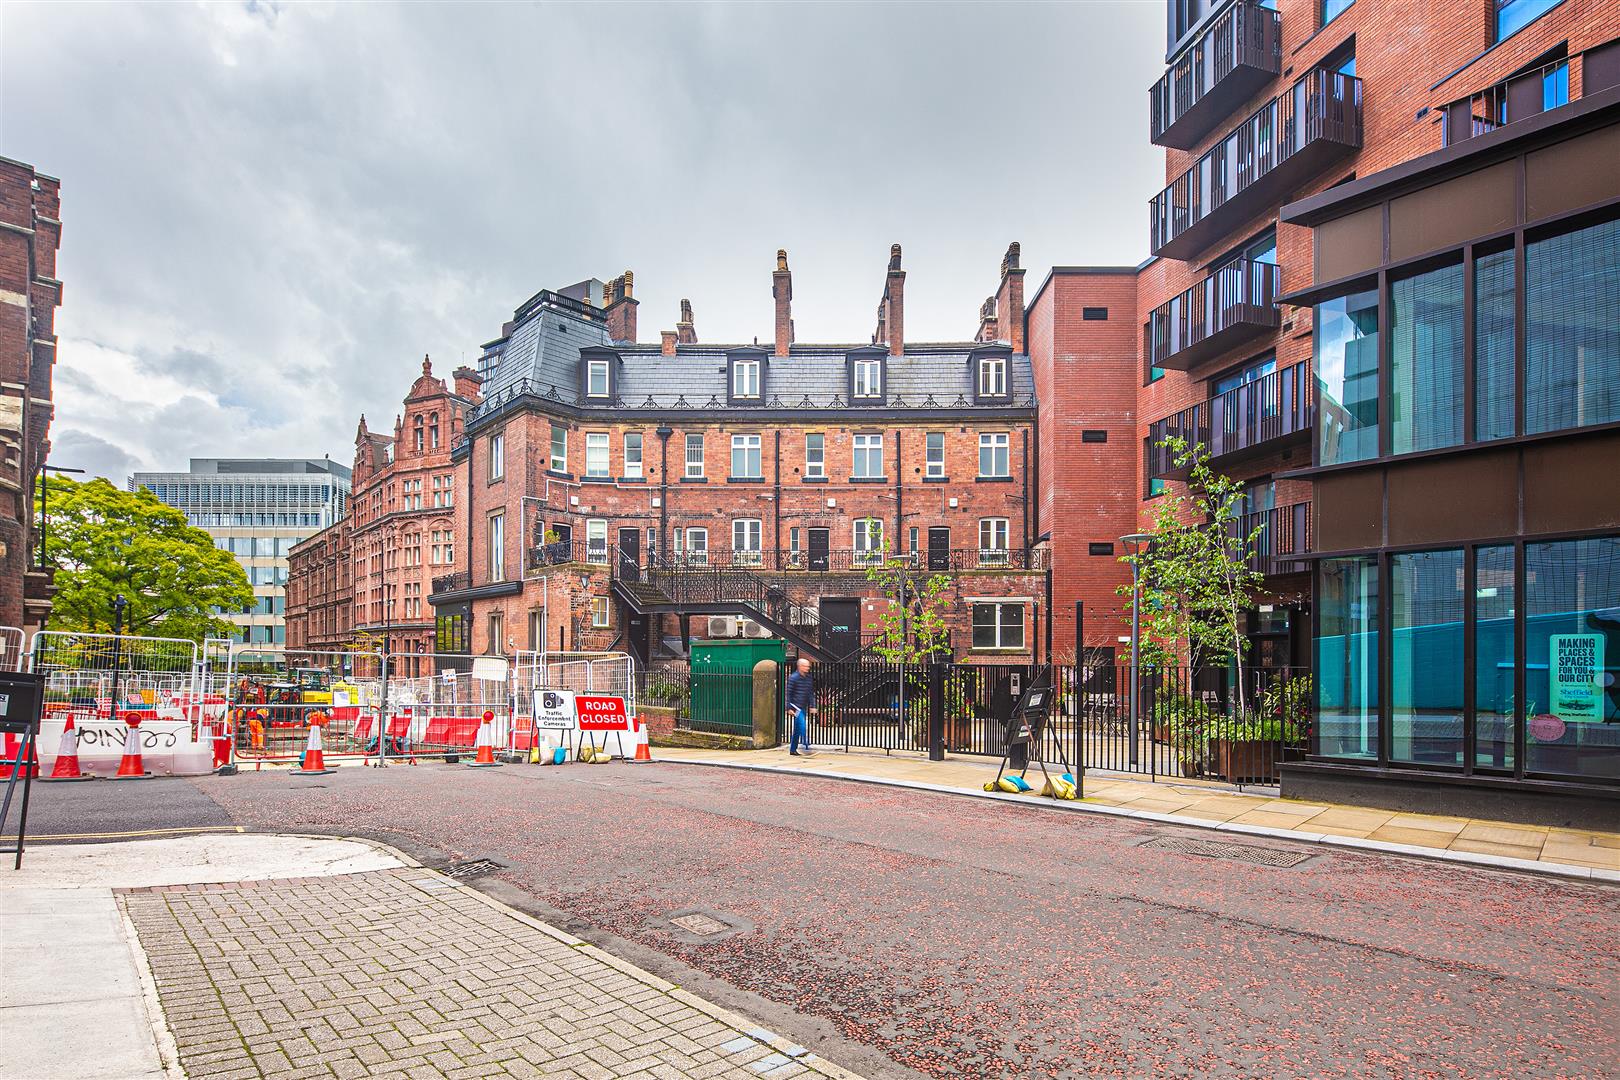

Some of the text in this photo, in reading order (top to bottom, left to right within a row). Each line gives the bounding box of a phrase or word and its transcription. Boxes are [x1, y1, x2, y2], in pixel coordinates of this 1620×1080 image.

[1558, 638, 1595, 648] MAKING
[1588, 649, 1595, 657] &
[1558, 657, 1595, 666] SPACES
[1588, 666, 1595, 674] &
[1558, 674, 1595, 682] OUR CITY
[586, 702, 616, 710] ROAD
[580, 714, 624, 724] CLOSED
